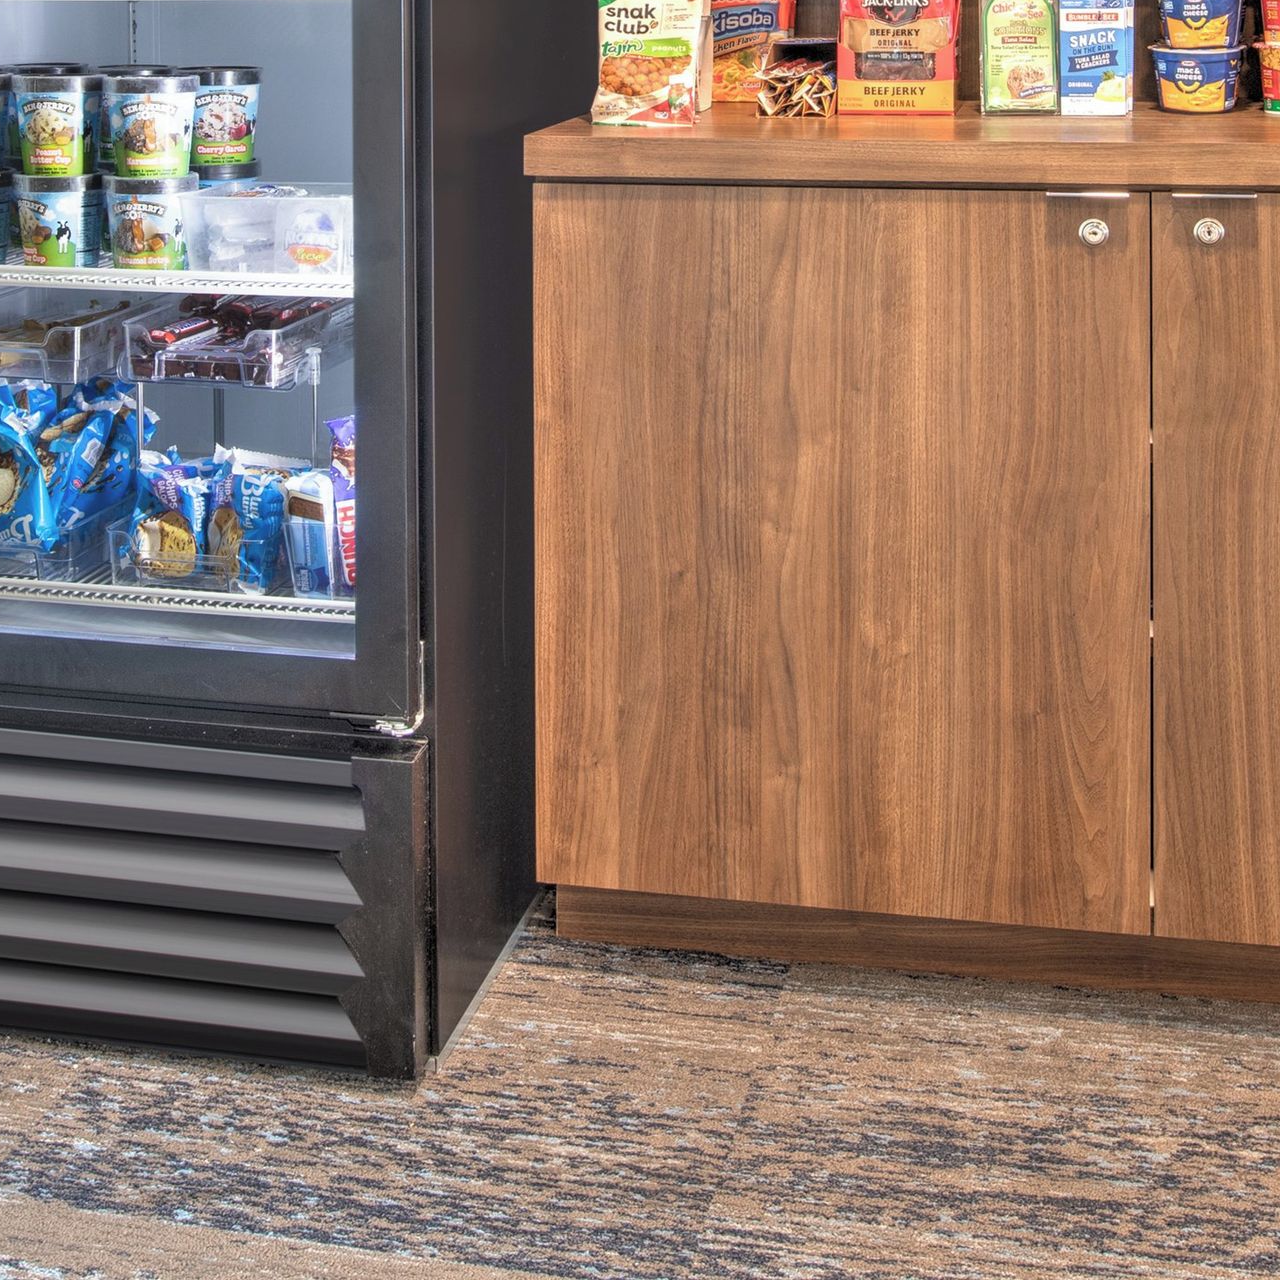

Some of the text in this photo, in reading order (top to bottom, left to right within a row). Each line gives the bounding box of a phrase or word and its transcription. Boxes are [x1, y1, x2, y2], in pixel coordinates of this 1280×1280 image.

[605, 3, 657, 19] snak
[1067, 12, 1117, 21] BUMBLE BEE
[604, 19, 653, 35] club
[869, 28, 921, 38] BEEF JERKY
[736, 35, 761, 49] Flavor
[877, 39, 913, 47] ORIGINAL
[1069, 30, 1117, 48] SNACK
[651, 43, 688, 53] peanuts
[1072, 47, 1096, 56] ON THE
[1074, 52, 1111, 65] TUNA SALAD
[863, 86, 927, 97] BEEF JERKY
[873, 99, 917, 108] ORIGINAL
[197, 144, 247, 156] Cherry Garcia
